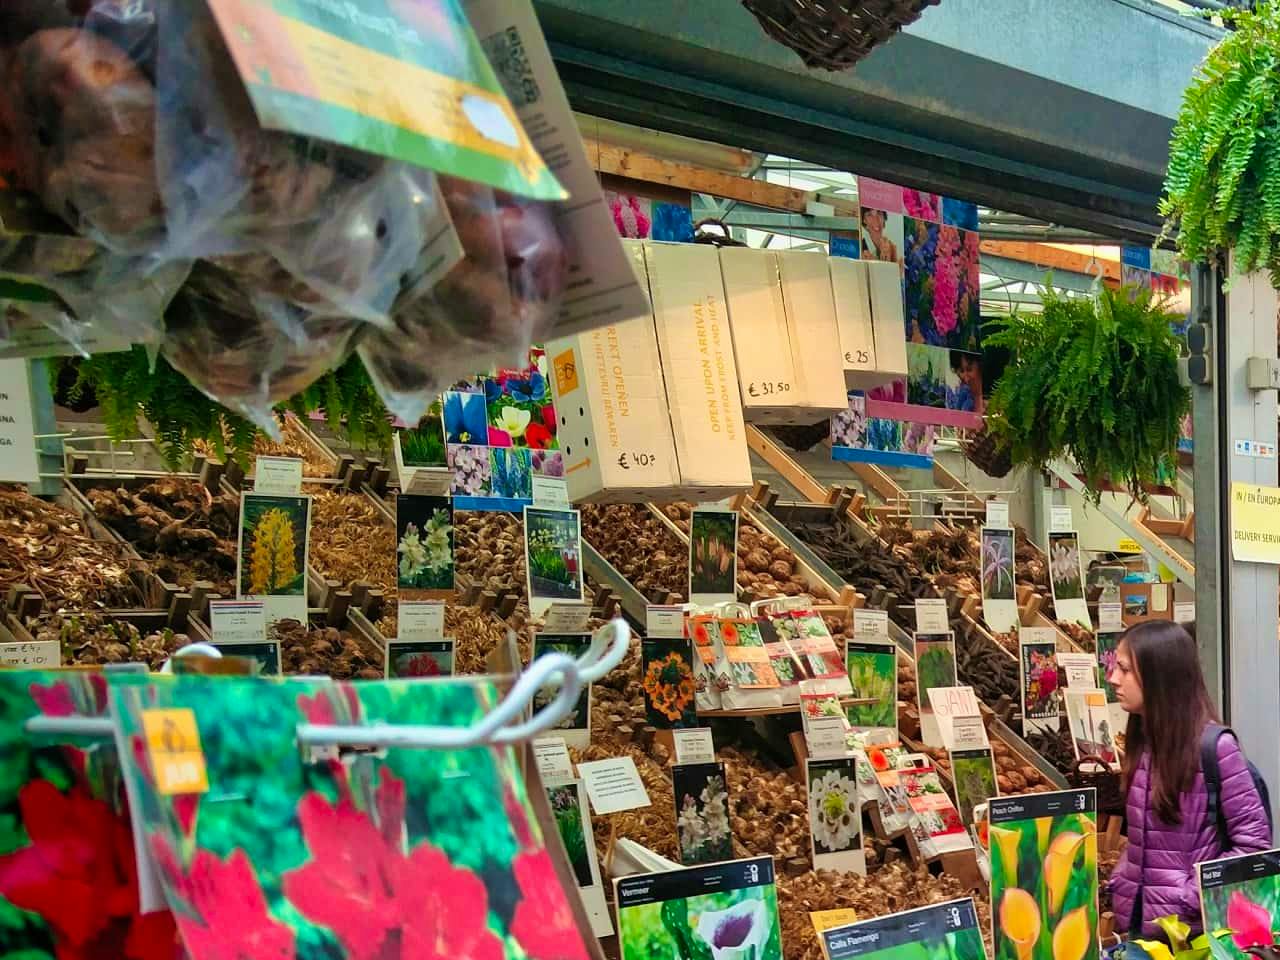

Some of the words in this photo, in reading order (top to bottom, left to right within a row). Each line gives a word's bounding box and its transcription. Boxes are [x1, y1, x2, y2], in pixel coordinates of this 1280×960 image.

[693, 303, 709, 354] ARRIVAL
[845, 352, 854, 364] €
[856, 351, 868, 364] 25
[702, 363, 716, 395] UPON
[612, 366, 630, 417] OPENEN
[749, 383, 761, 398] €
[708, 400, 721, 433] OPEN
[617, 452, 630, 469] €
[1236, 491, 1243, 501] IN
[1247, 492, 1256, 503] EN
[1234, 530, 1261, 543] DELIVERY
[621, 887, 650, 898] Vermeer
[829, 938, 848, 951] Calla
